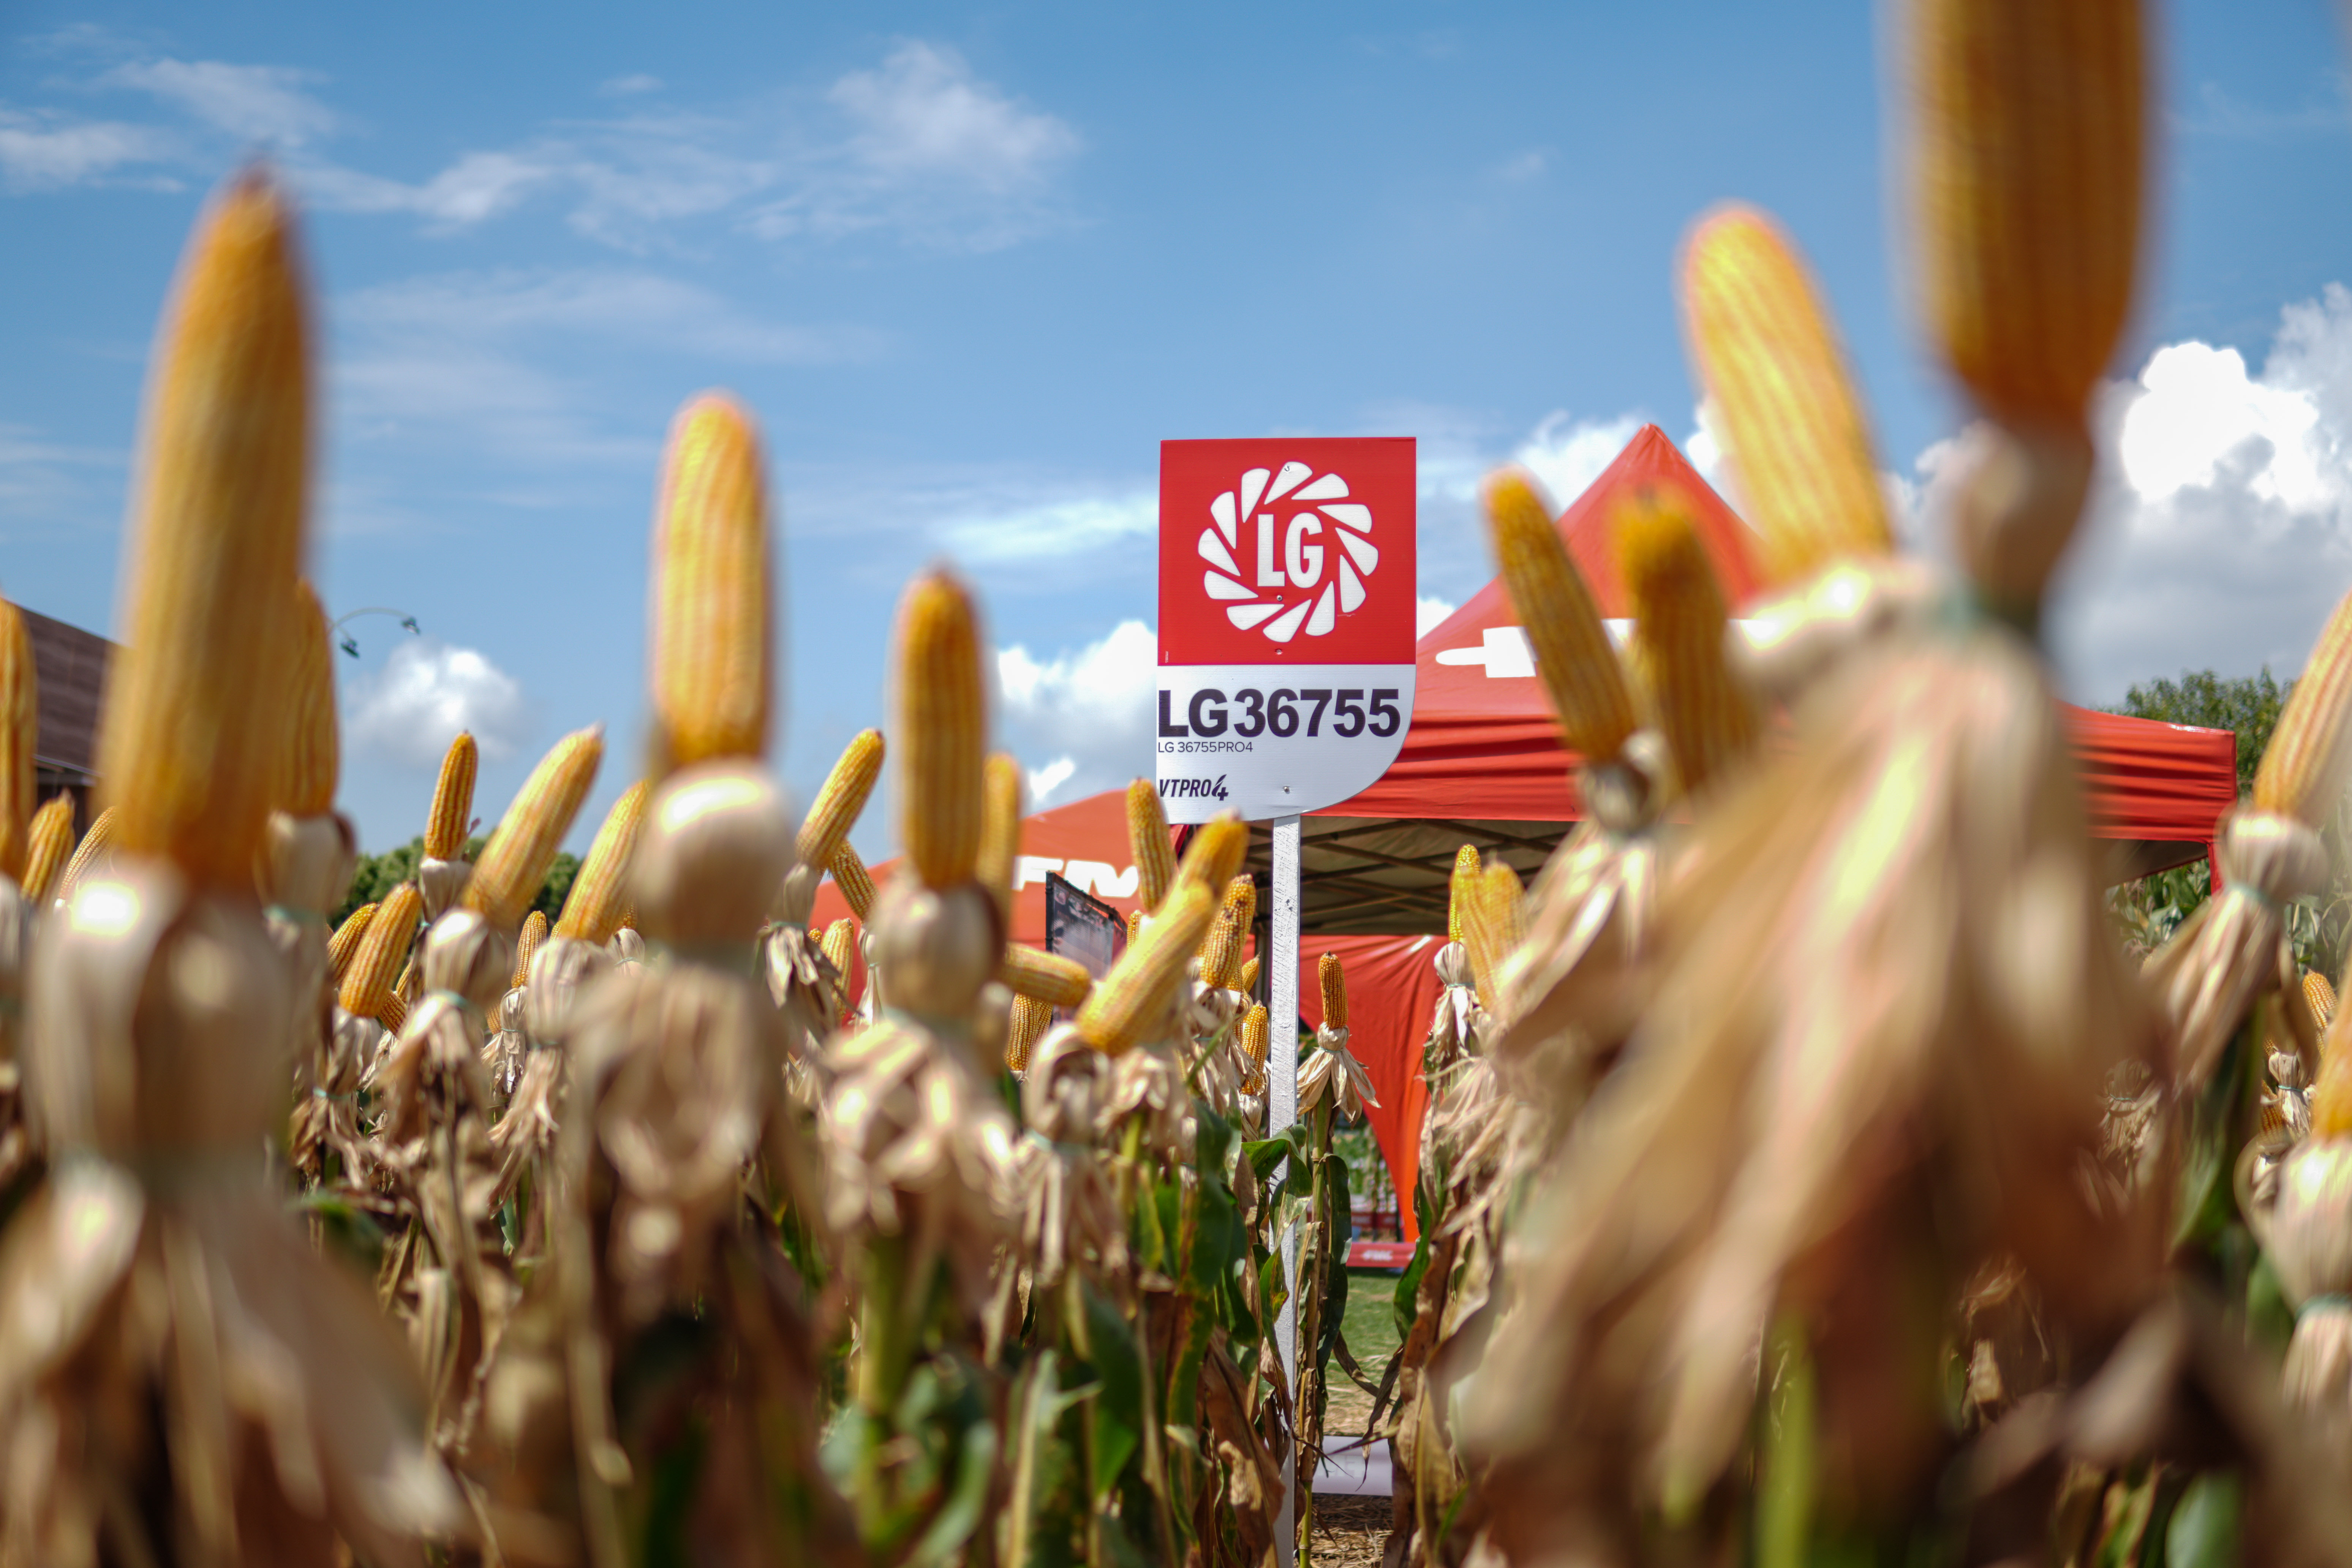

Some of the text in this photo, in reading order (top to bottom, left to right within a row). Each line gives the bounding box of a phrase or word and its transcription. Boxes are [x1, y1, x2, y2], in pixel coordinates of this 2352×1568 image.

[1257, 512, 1324, 589] LG
[1158, 741, 1253, 752] LG 36755PRO4
[1160, 774, 1229, 801] VTPRO4
